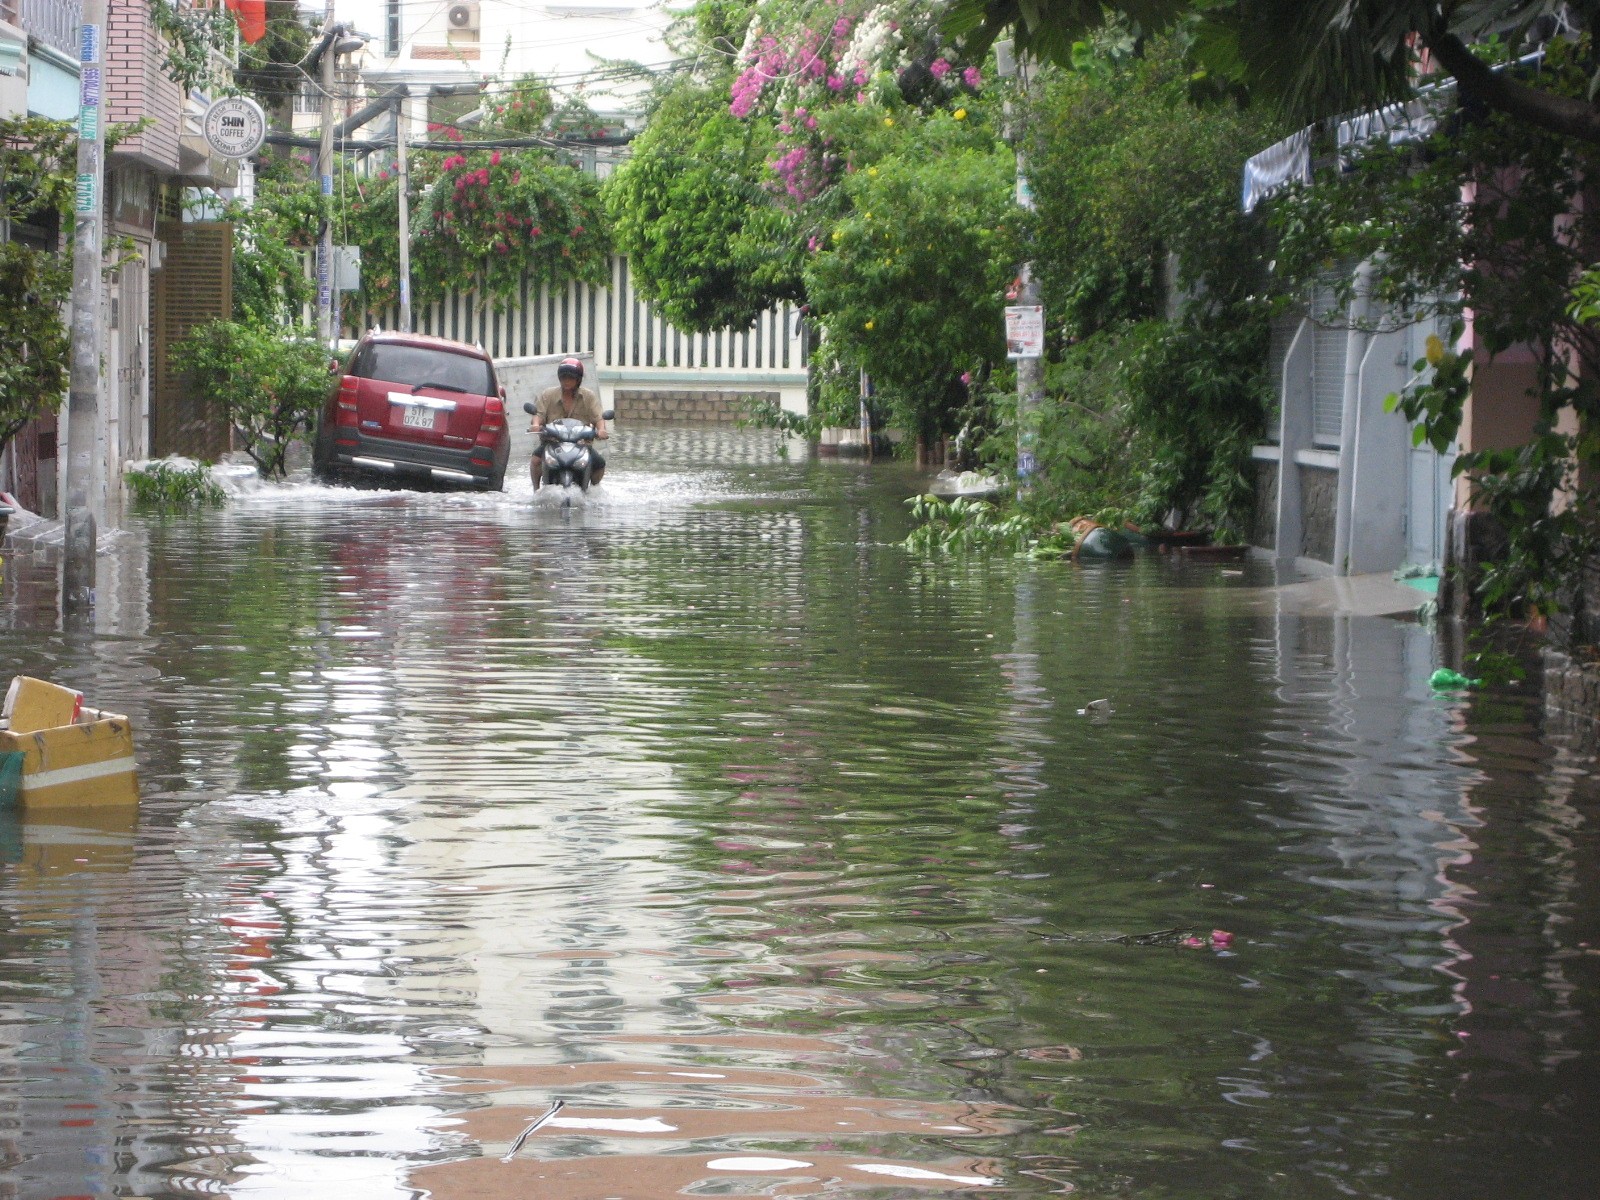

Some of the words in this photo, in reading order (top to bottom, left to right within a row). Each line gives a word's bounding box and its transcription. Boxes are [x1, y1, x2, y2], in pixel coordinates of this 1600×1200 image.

[212, 106, 227, 122] FRESH
[247, 110, 257, 124] MILK
[221, 116, 245, 127] SHIN
[220, 128, 245, 138] COFFEE
[241, 136, 255, 149] FOOD
